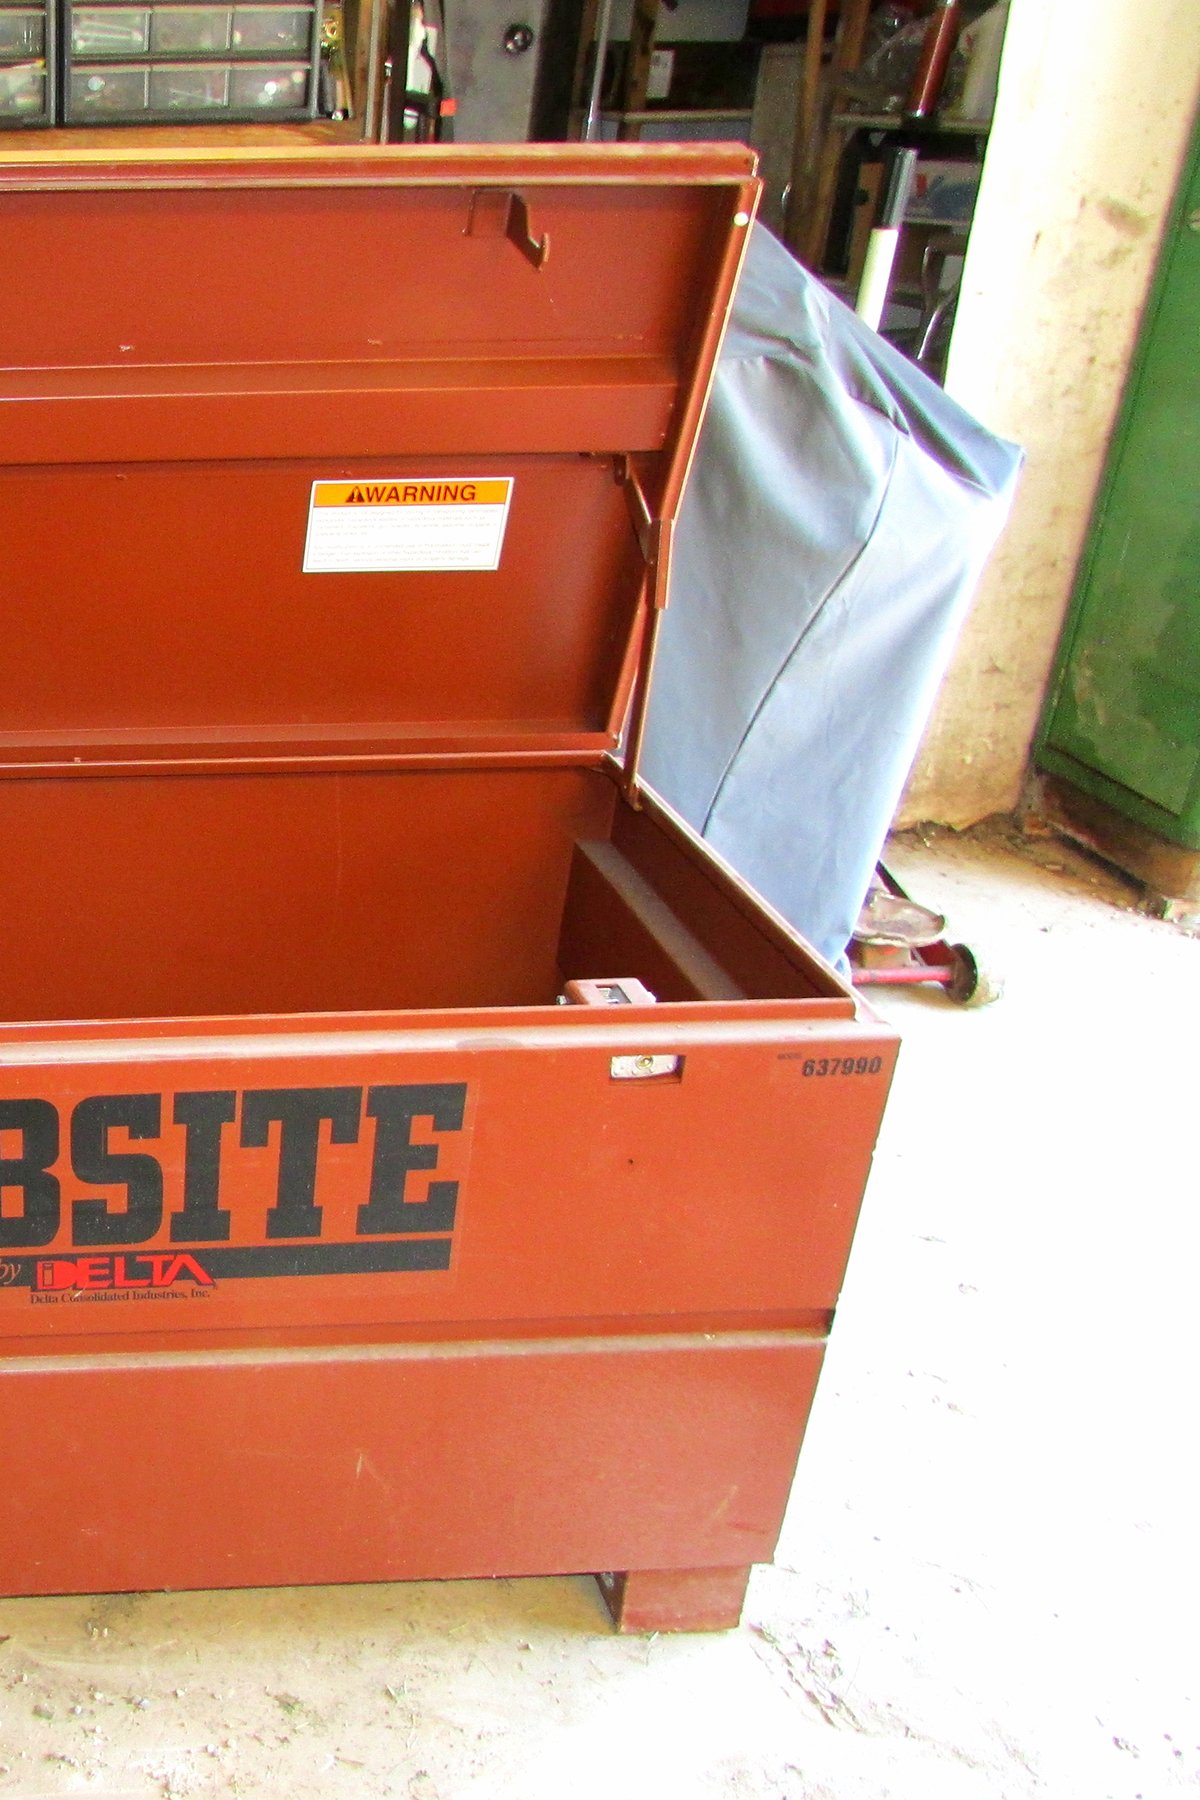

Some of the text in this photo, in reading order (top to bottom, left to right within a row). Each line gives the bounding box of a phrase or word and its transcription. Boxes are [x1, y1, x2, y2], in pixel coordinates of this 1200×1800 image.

[365, 484, 477, 503] WARNING
[802, 1056, 883, 1077] 637990
[36, 1254, 215, 1291] DELTA
[30, 1288, 211, 1304] Delta Consolidated Industries, Inc.
